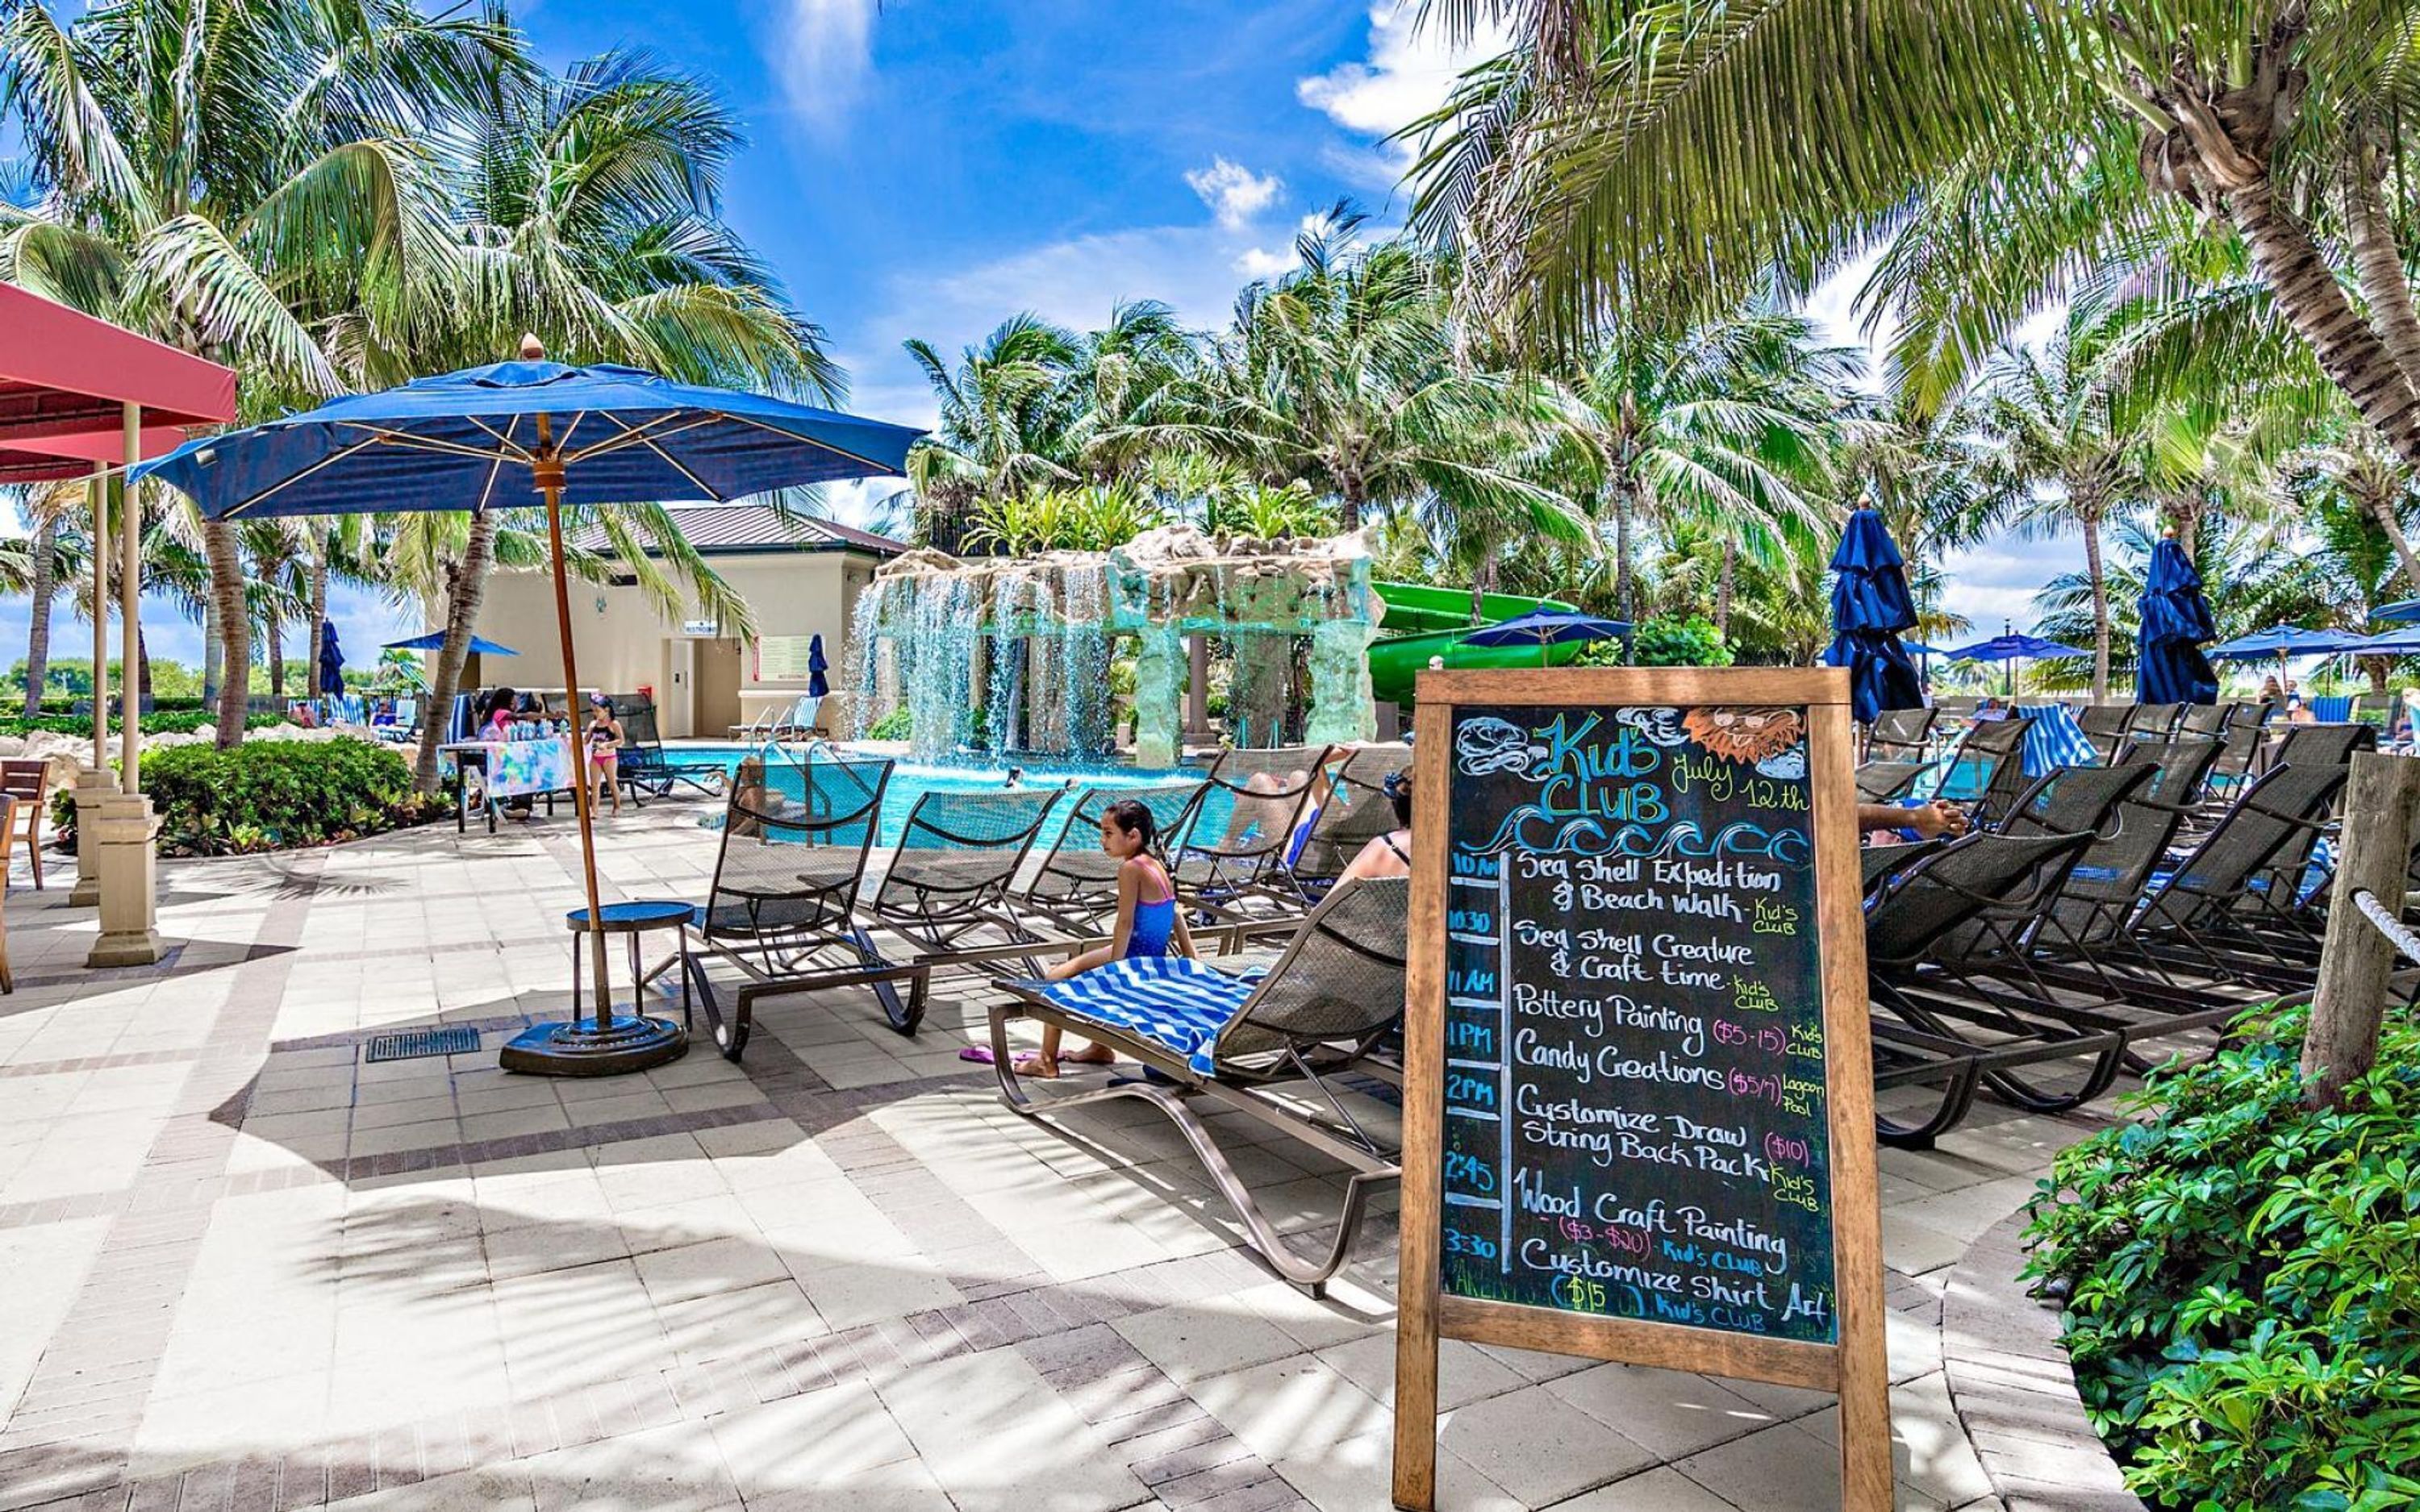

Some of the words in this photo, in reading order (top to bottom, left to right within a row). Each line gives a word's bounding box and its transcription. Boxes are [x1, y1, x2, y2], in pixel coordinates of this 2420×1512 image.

[1671, 753, 1733, 802] July
[1517, 851, 1570, 879] Sea
[1575, 856, 1640, 882] Shell
[1652, 860, 1781, 893] Expedition
[1580, 884, 1663, 910] Beach
[1512, 919, 1570, 949] Sea
[1576, 928, 1642, 956] Shell
[1652, 934, 1755, 965] Creature
[1580, 953, 1653, 981] Craft
[1512, 983, 1604, 1037] Pottery
[1605, 994, 1704, 1057] Painting
[1514, 1027, 1590, 1083] Candy
[1596, 1045, 1725, 1090] Creations
[1783, 1073, 1825, 1101] Lagoon
[1517, 1084, 1660, 1132] Customize
[1664, 1114, 1747, 1147] Draw
[1782, 1095, 1812, 1117] Pool
[1522, 1120, 1613, 1167] String
[1446, 1150, 1493, 1190] 2:45
[1513, 1167, 1581, 1218] Wood
[1595, 1193, 1677, 1232] Craft
[1675, 1206, 1787, 1276] Painting
[1521, 1238, 1684, 1293] Customize
[1690, 1276, 1776, 1310] Shirt
